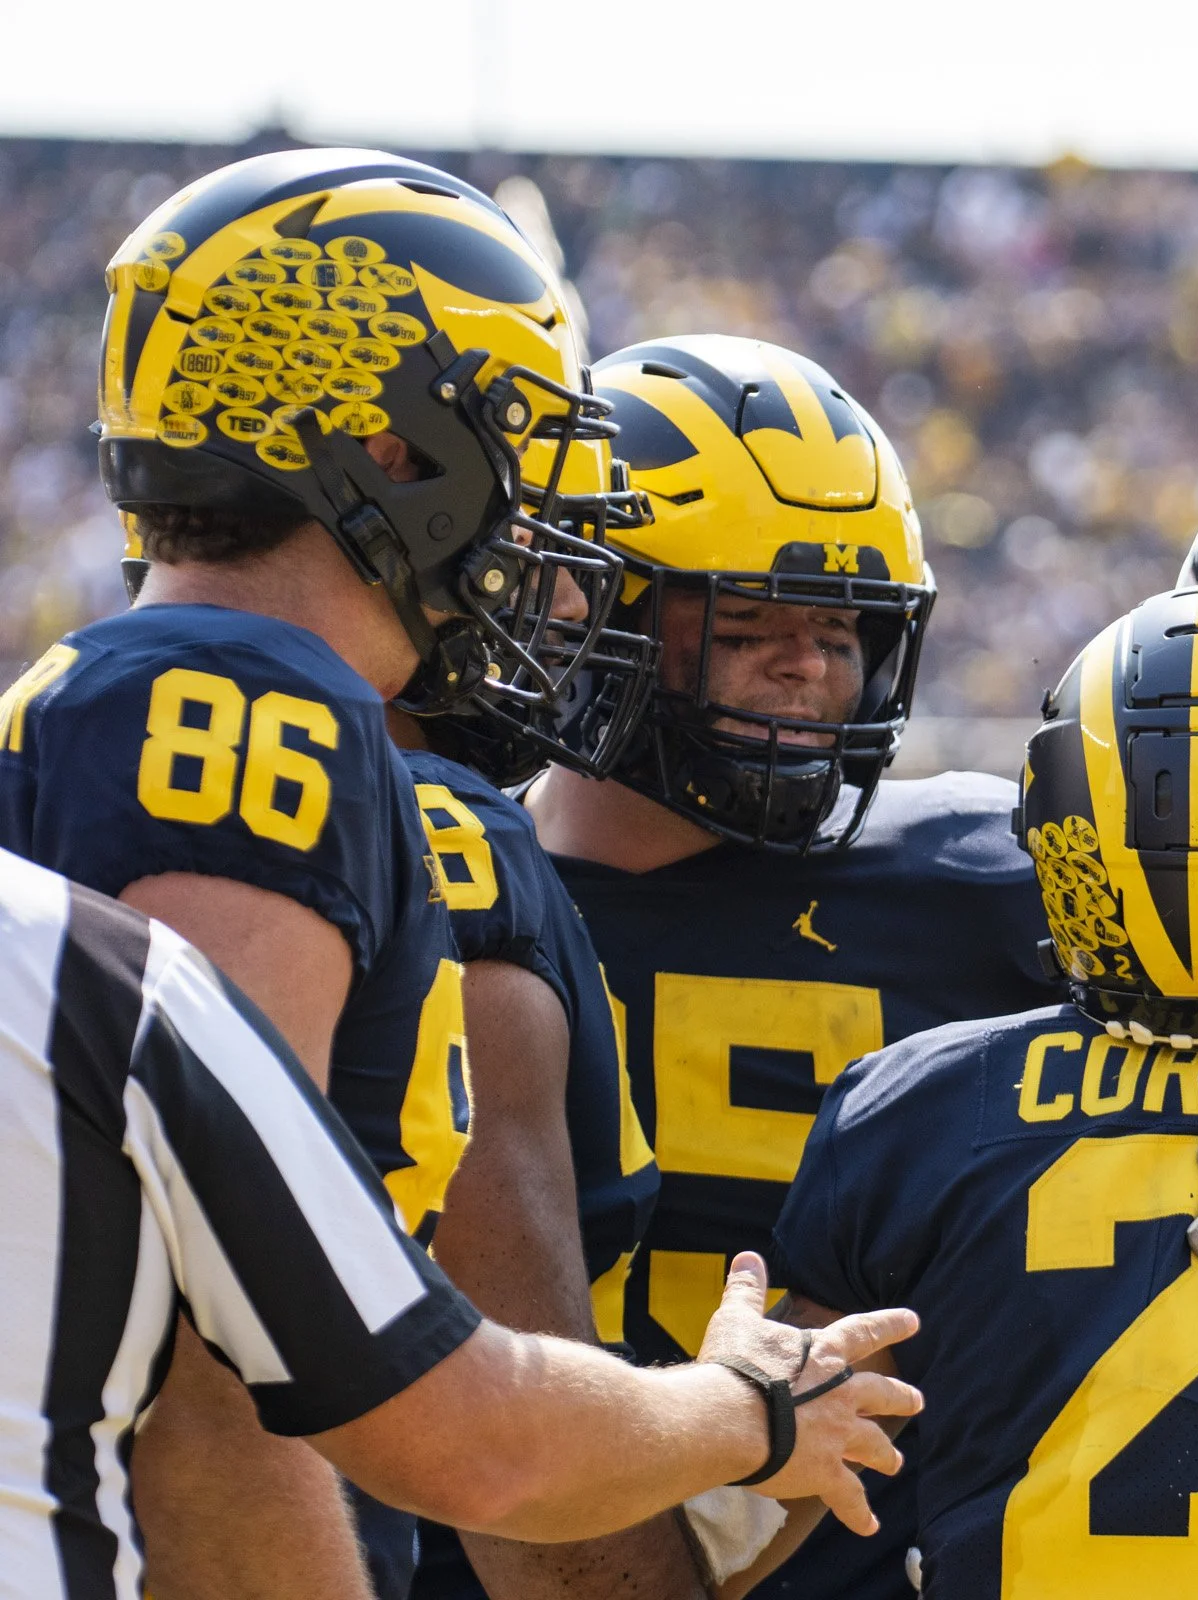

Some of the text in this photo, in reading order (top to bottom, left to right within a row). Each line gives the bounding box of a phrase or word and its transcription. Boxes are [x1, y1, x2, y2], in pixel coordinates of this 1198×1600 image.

[181, 353, 220, 373] (860)
[227, 415, 266, 433] TED
[823, 543, 859, 574] M
[137, 667, 340, 852] 86
[1113, 953, 1134, 981] 2
